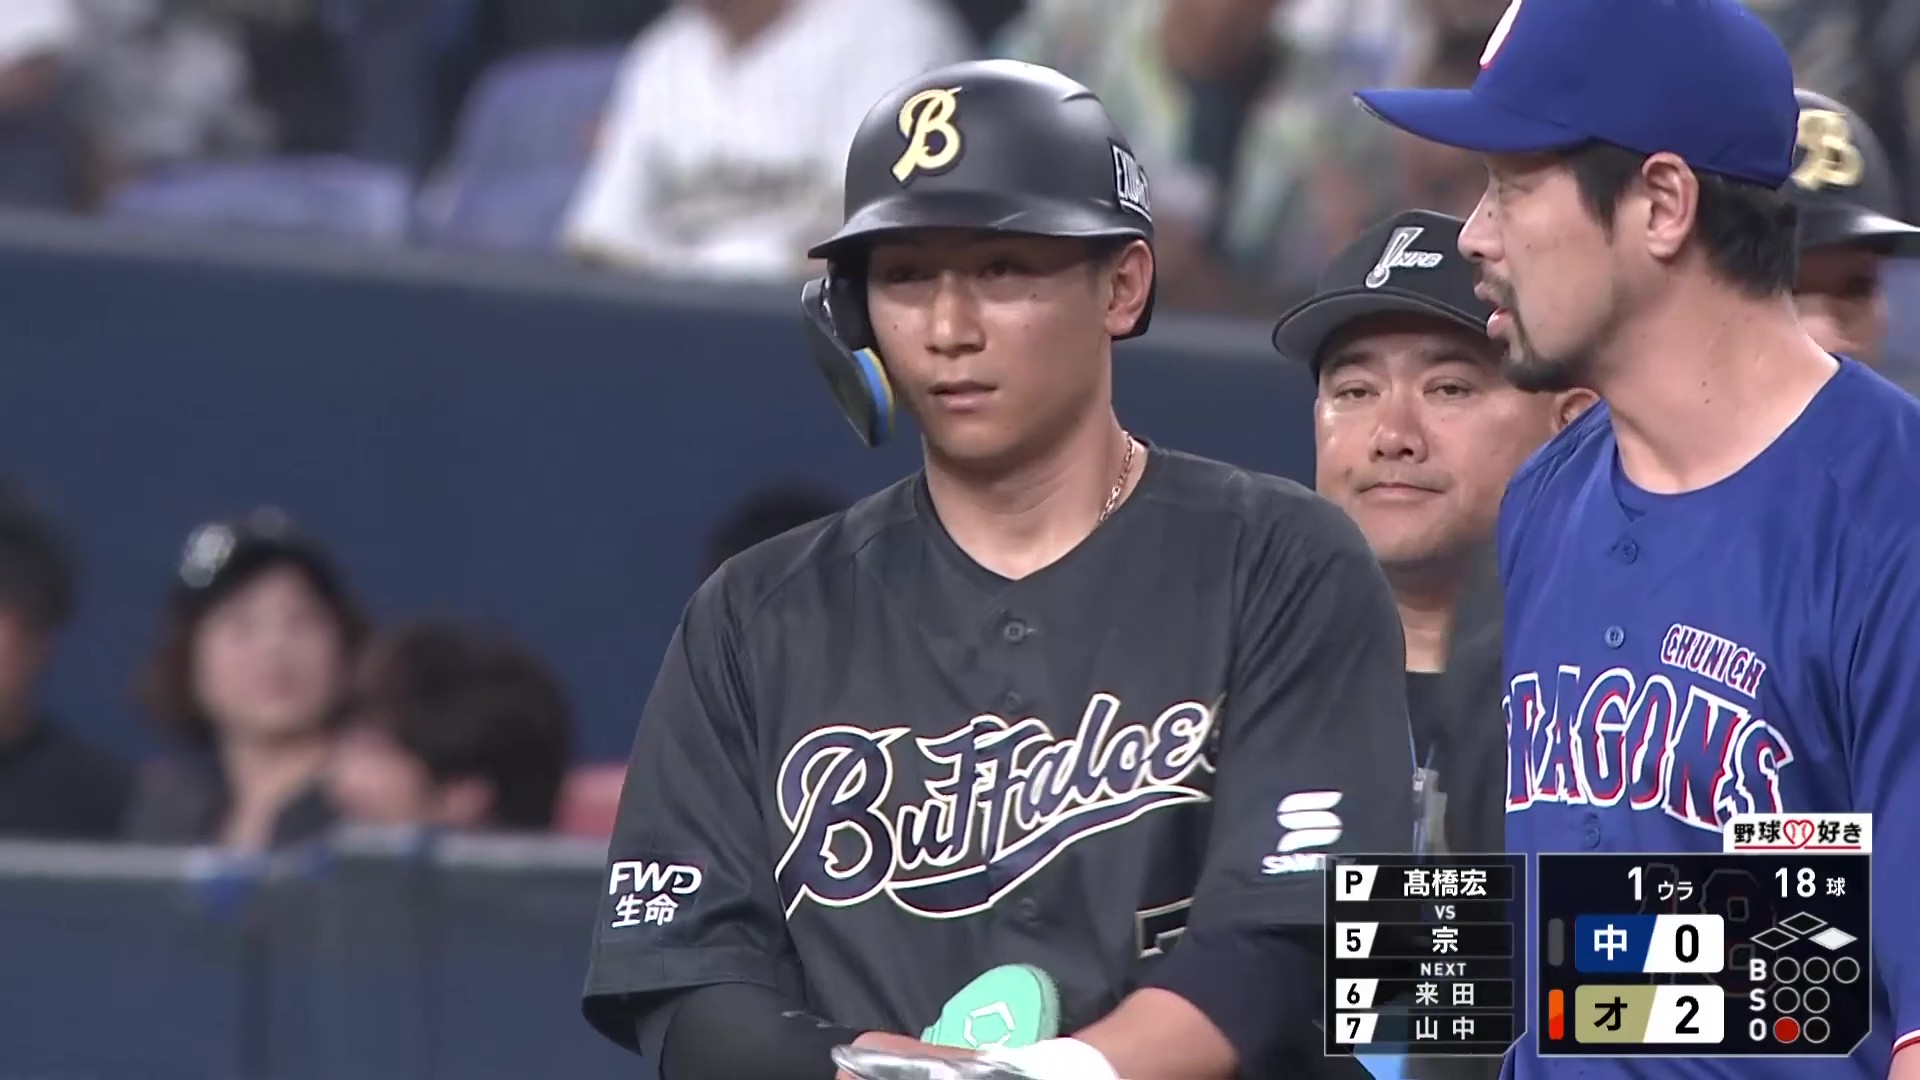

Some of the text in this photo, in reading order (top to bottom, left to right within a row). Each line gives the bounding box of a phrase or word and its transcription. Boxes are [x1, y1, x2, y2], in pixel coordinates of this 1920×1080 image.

[890, 83, 963, 183] B
[1792, 108, 1864, 190] B
[1502, 665, 1794, 832] RAGONS
[609, 861, 702, 895] FWD
[612, 893, 679, 928] 生命
